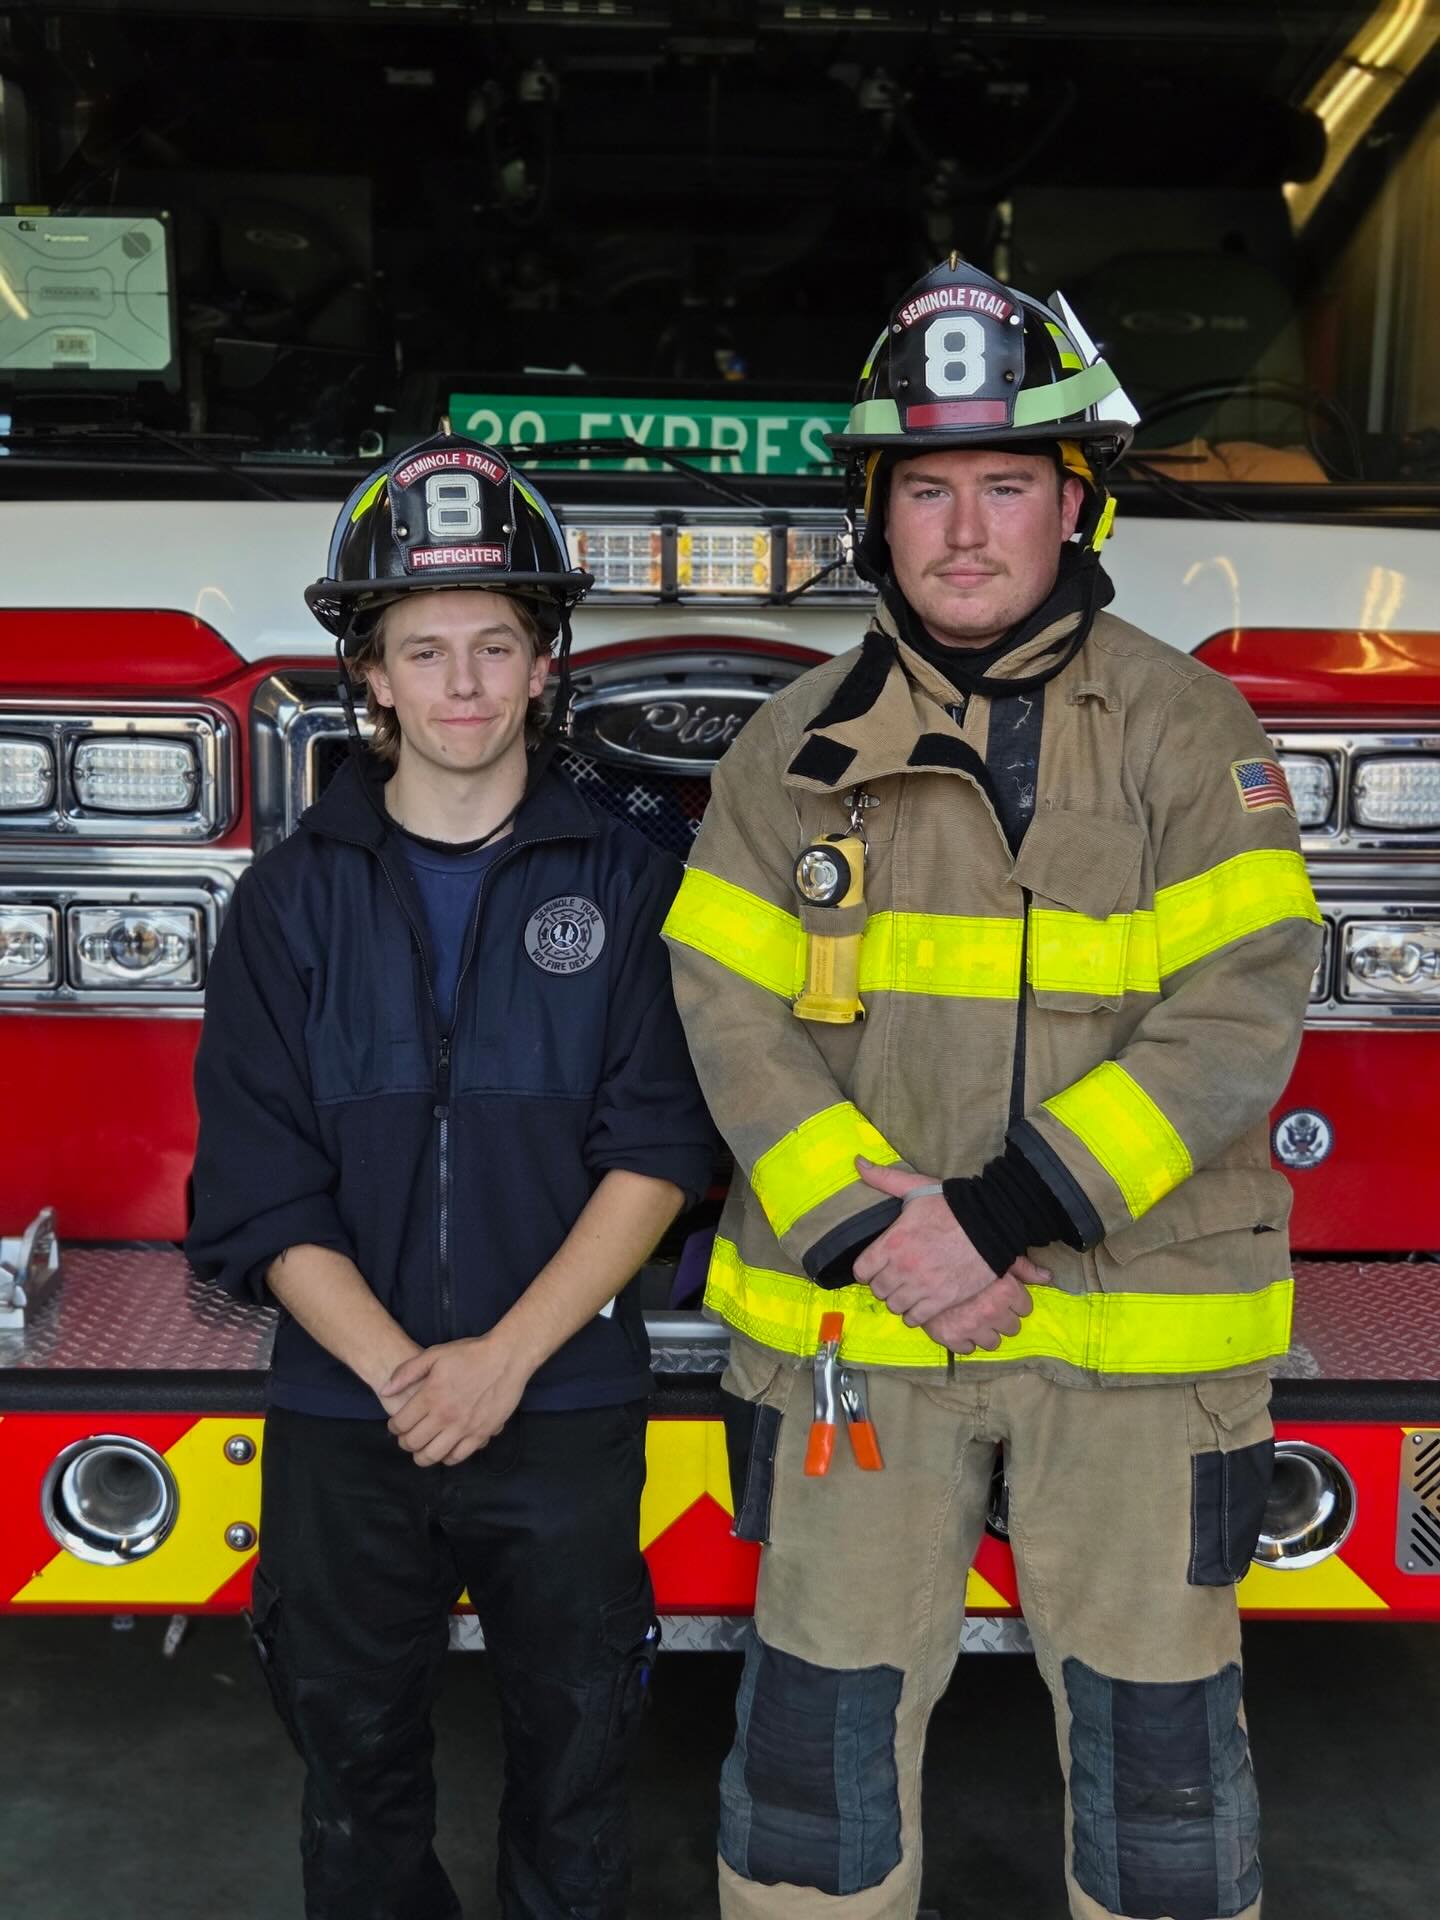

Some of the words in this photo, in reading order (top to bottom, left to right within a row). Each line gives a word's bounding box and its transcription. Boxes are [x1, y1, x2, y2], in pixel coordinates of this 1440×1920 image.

[902, 288, 966, 326] SEMINOLE
[969, 289, 1007, 320] TRAIL
[924, 316, 986, 397] 8
[579, 413, 850, 475] EXPRES
[399, 453, 460, 483] SEMINOLE
[465, 453, 497, 479] TRAIL
[425, 474, 482, 537] 8
[413, 549, 502, 567] FIREFIGHTER
[628, 701, 742, 750] Pier
[534, 898, 576, 922] SEMINOLE
[580, 901, 600, 925] TRAIL
[545, 959, 567, 971] FIRE
